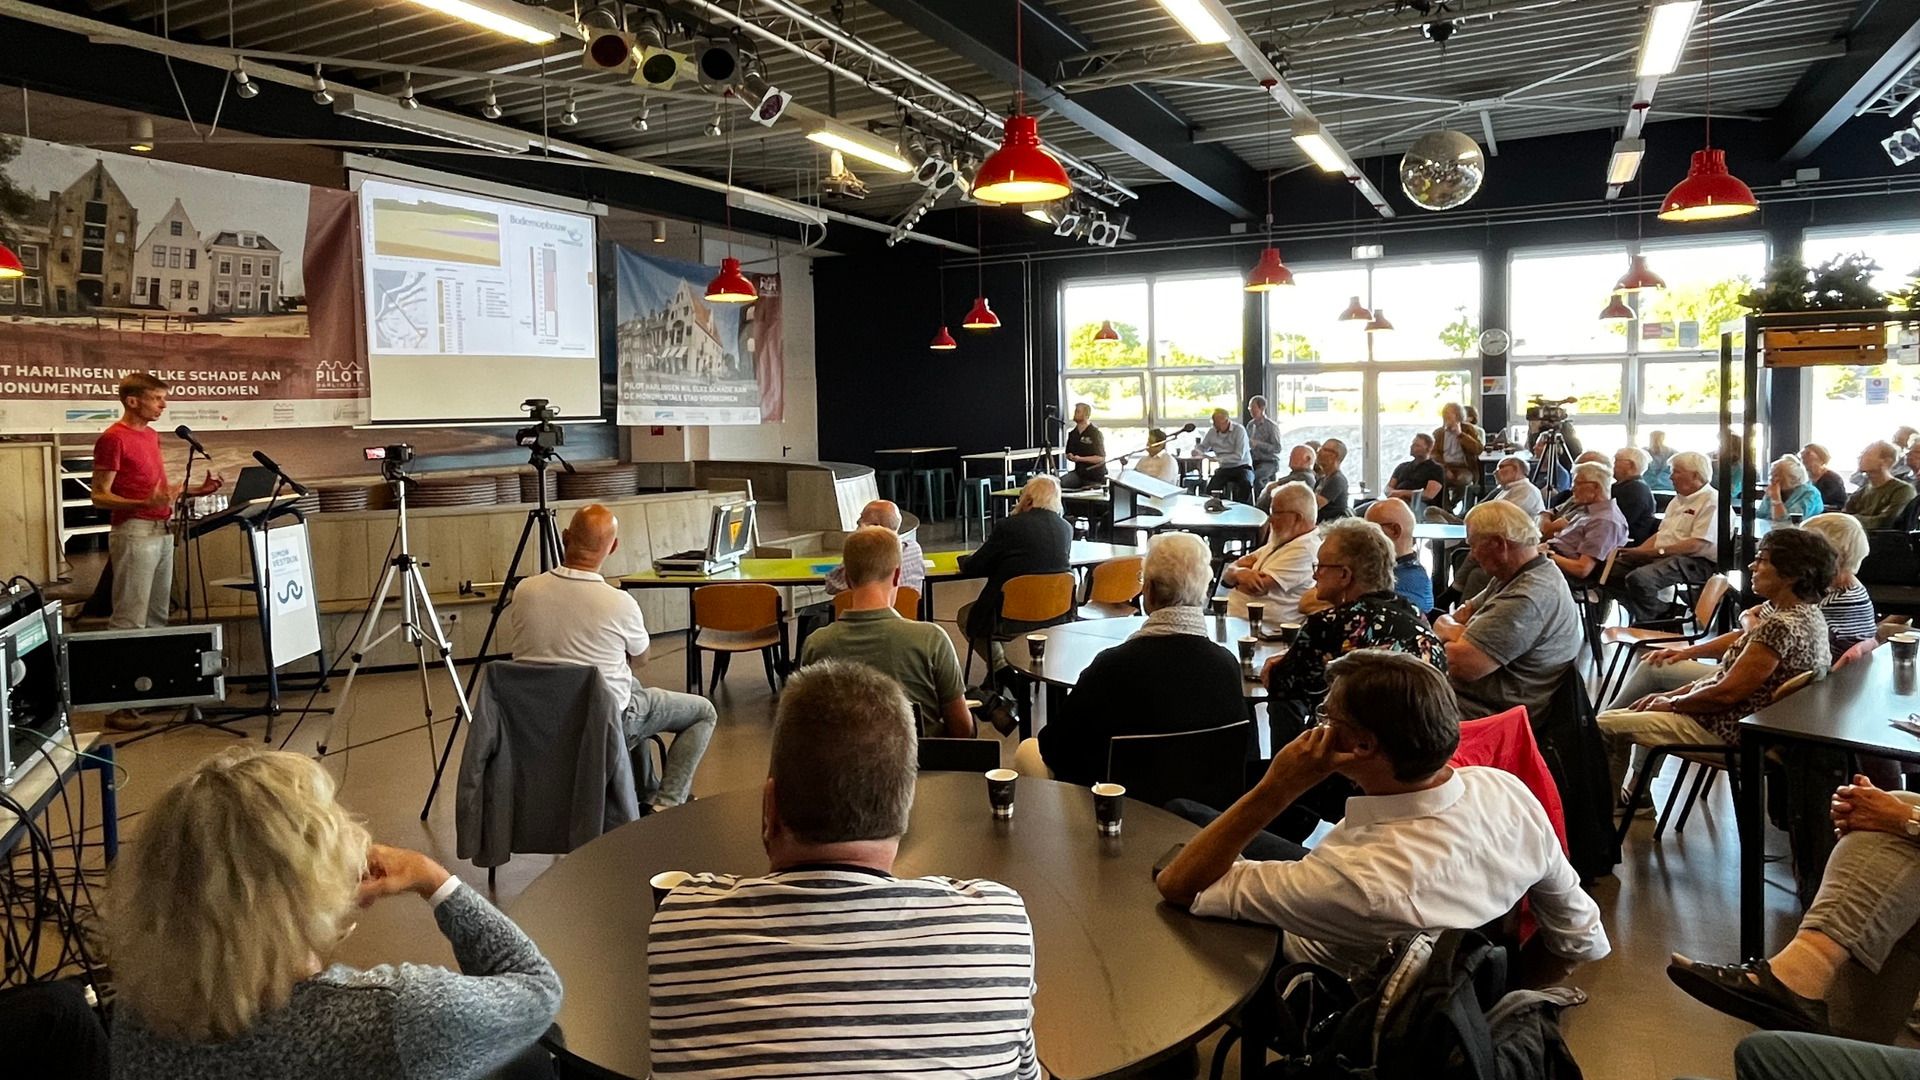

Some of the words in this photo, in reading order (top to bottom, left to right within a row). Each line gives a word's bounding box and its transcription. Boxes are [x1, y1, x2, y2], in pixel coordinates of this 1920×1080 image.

[16, 365, 114, 379] HARLINGEN
[189, 370, 248, 381] SCHADE
[251, 370, 281, 381] AAN
[316, 370, 363, 382] PILOT
[0, 381, 119, 395] ONUMENTALE
[624, 382, 645, 391] PILOT
